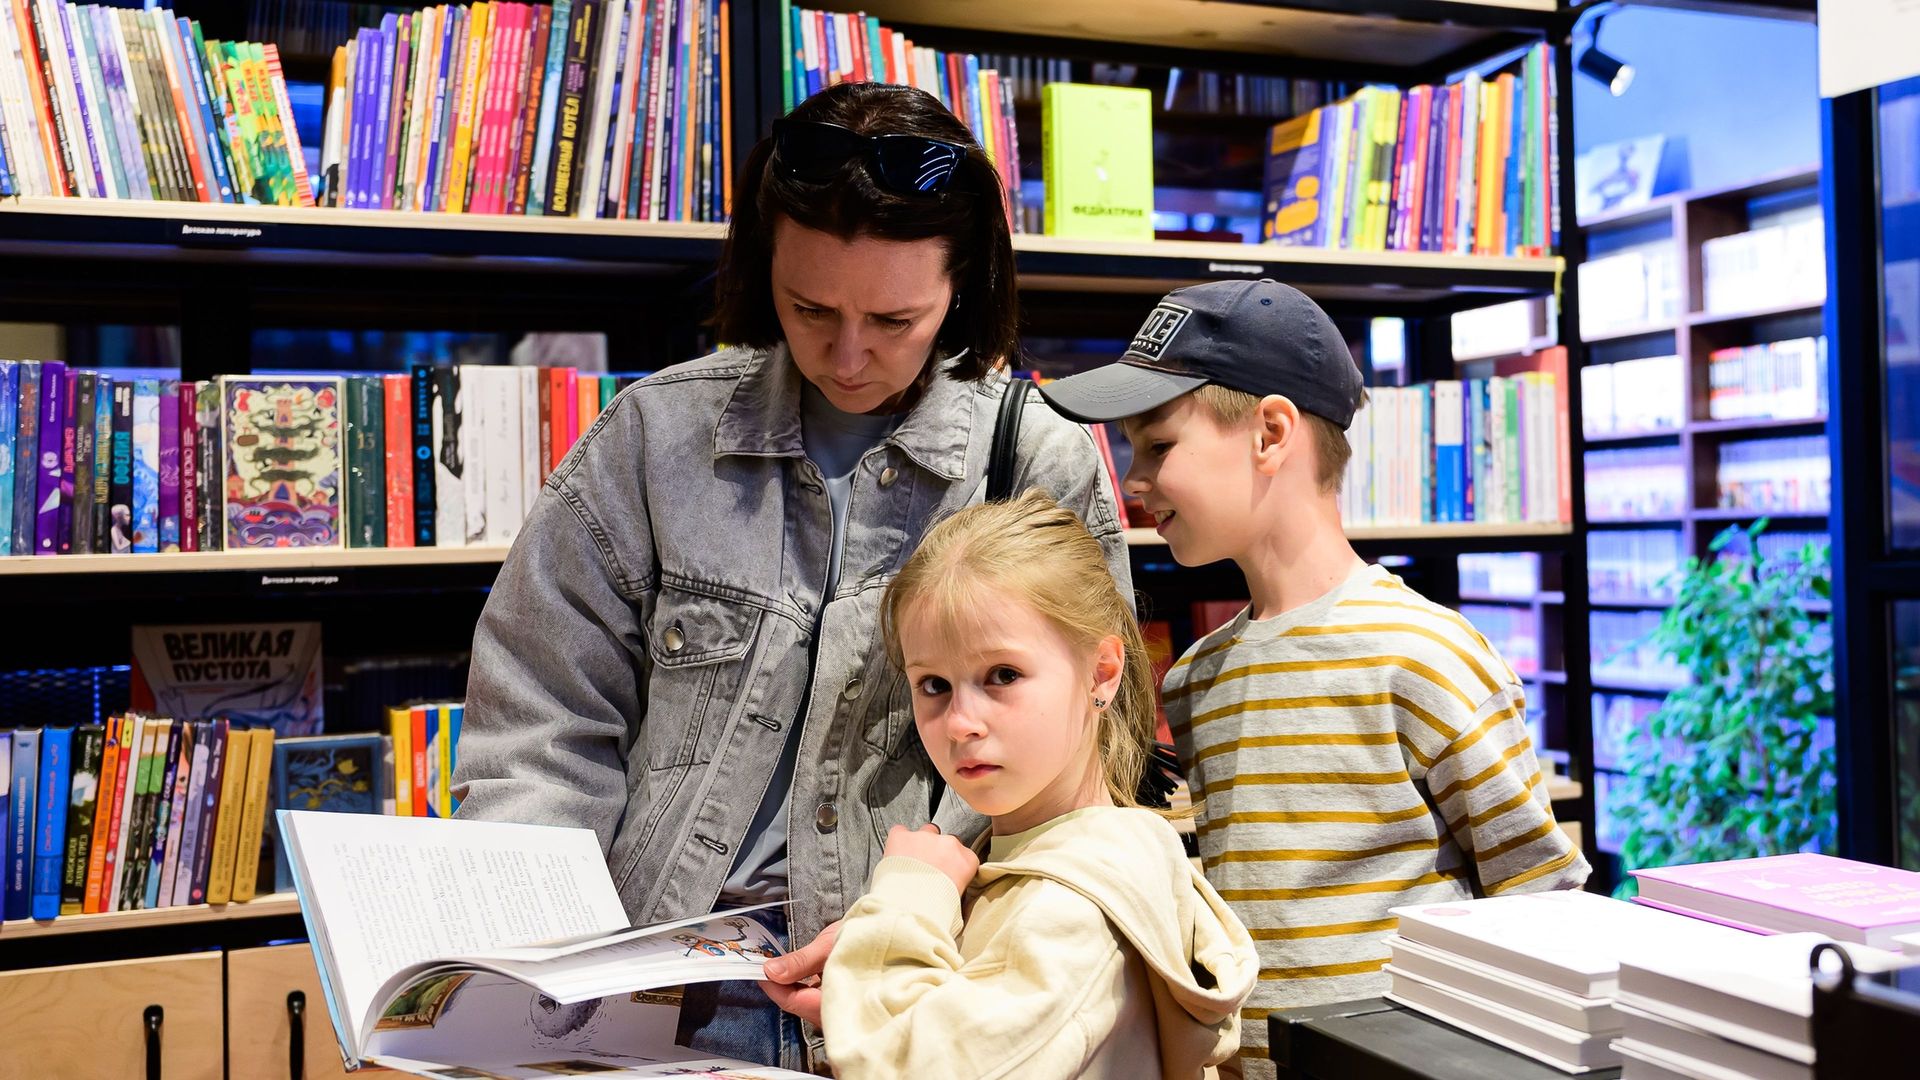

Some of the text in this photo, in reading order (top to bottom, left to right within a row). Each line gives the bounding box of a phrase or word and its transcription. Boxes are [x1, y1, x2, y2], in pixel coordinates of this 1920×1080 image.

[552, 97, 580, 212] ВОЛШЕБНЫЙ КОТЁЛ
[114, 431, 130, 484] ОФЕЛИЯ
[163, 629, 296, 661] ВЕЛИКАЯ
[173, 660, 272, 683] ПУСТОТА
